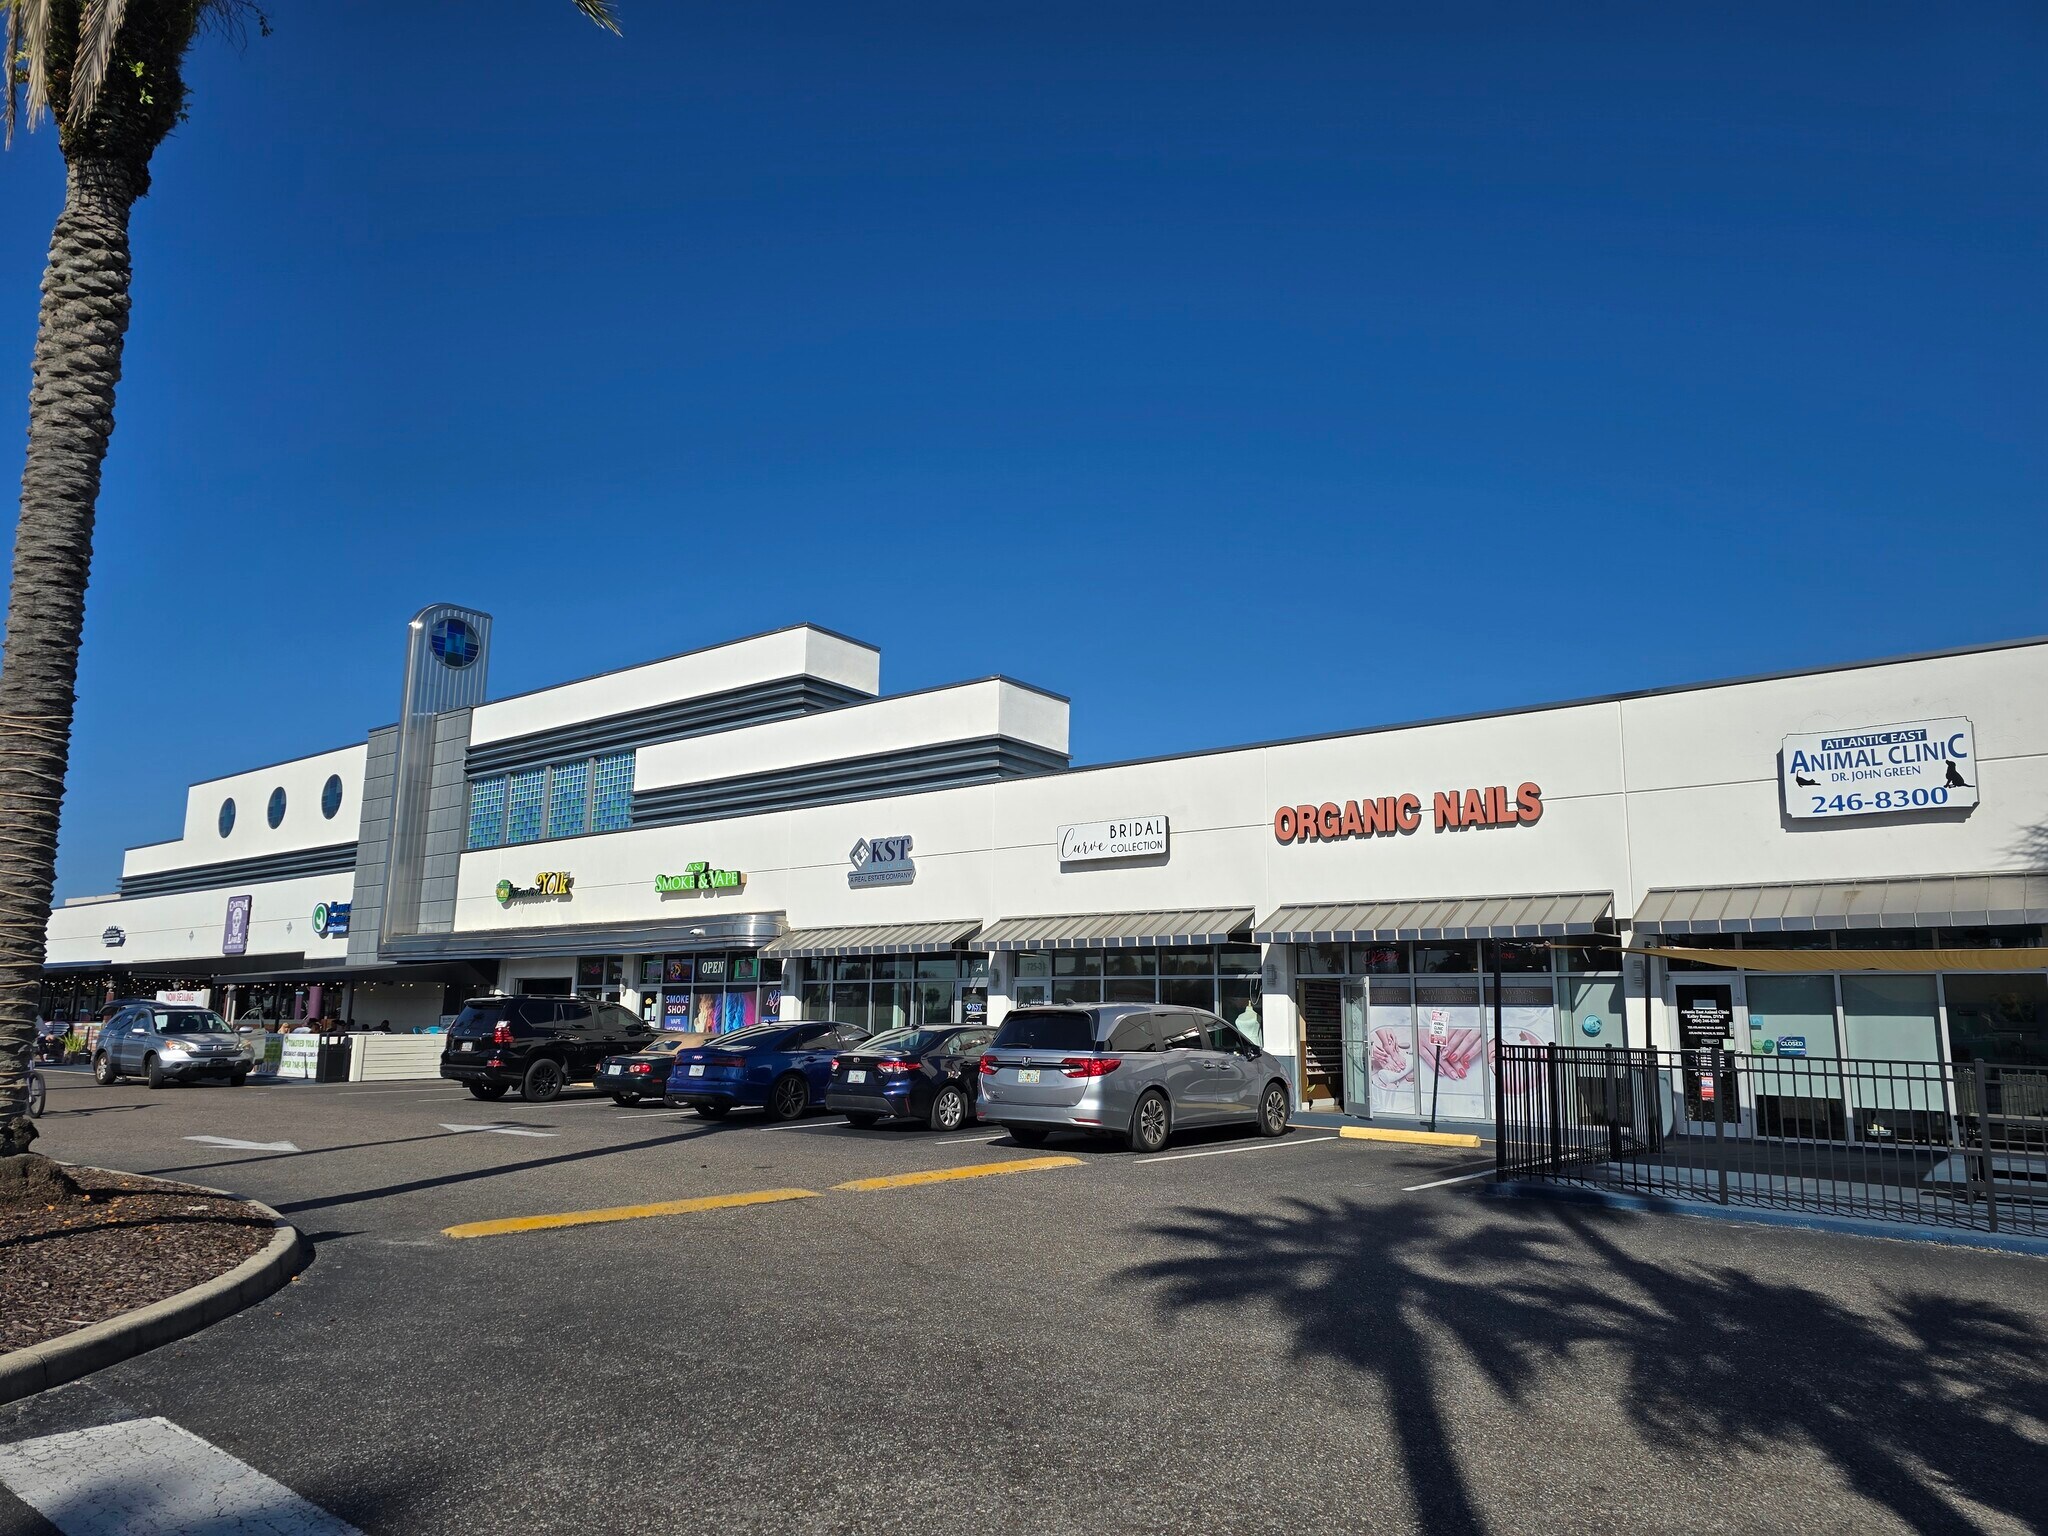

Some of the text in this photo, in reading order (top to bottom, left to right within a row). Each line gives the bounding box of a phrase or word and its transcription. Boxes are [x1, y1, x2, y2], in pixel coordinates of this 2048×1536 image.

[1824, 730, 1924, 750] ATLANTIC EAST
[1790, 733, 1968, 774] ANIMAL CLINIC
[1831, 765, 1921, 782] DR. JOHN GREEN
[1811, 786, 1948, 814] 246-8300
[1274, 782, 1544, 843] ORGANIC NAILS
[1109, 820, 1163, 839] BRIDAL
[870, 838, 910, 863] KST
[1061, 827, 1109, 859] Curve
[1110, 840, 1163, 854] COLLECTION
[535, 871, 568, 895] Yolk
[655, 870, 738, 893] SMOKE & VAPE
[868, 874, 886, 882] ESTATE
[886, 872, 912, 880] COMPANY
[702, 961, 724, 974] OPEN
[177, 992, 194, 1001] SELLING
[666, 994, 689, 1004] SMOKE
[667, 1005, 686, 1014] SHOP
